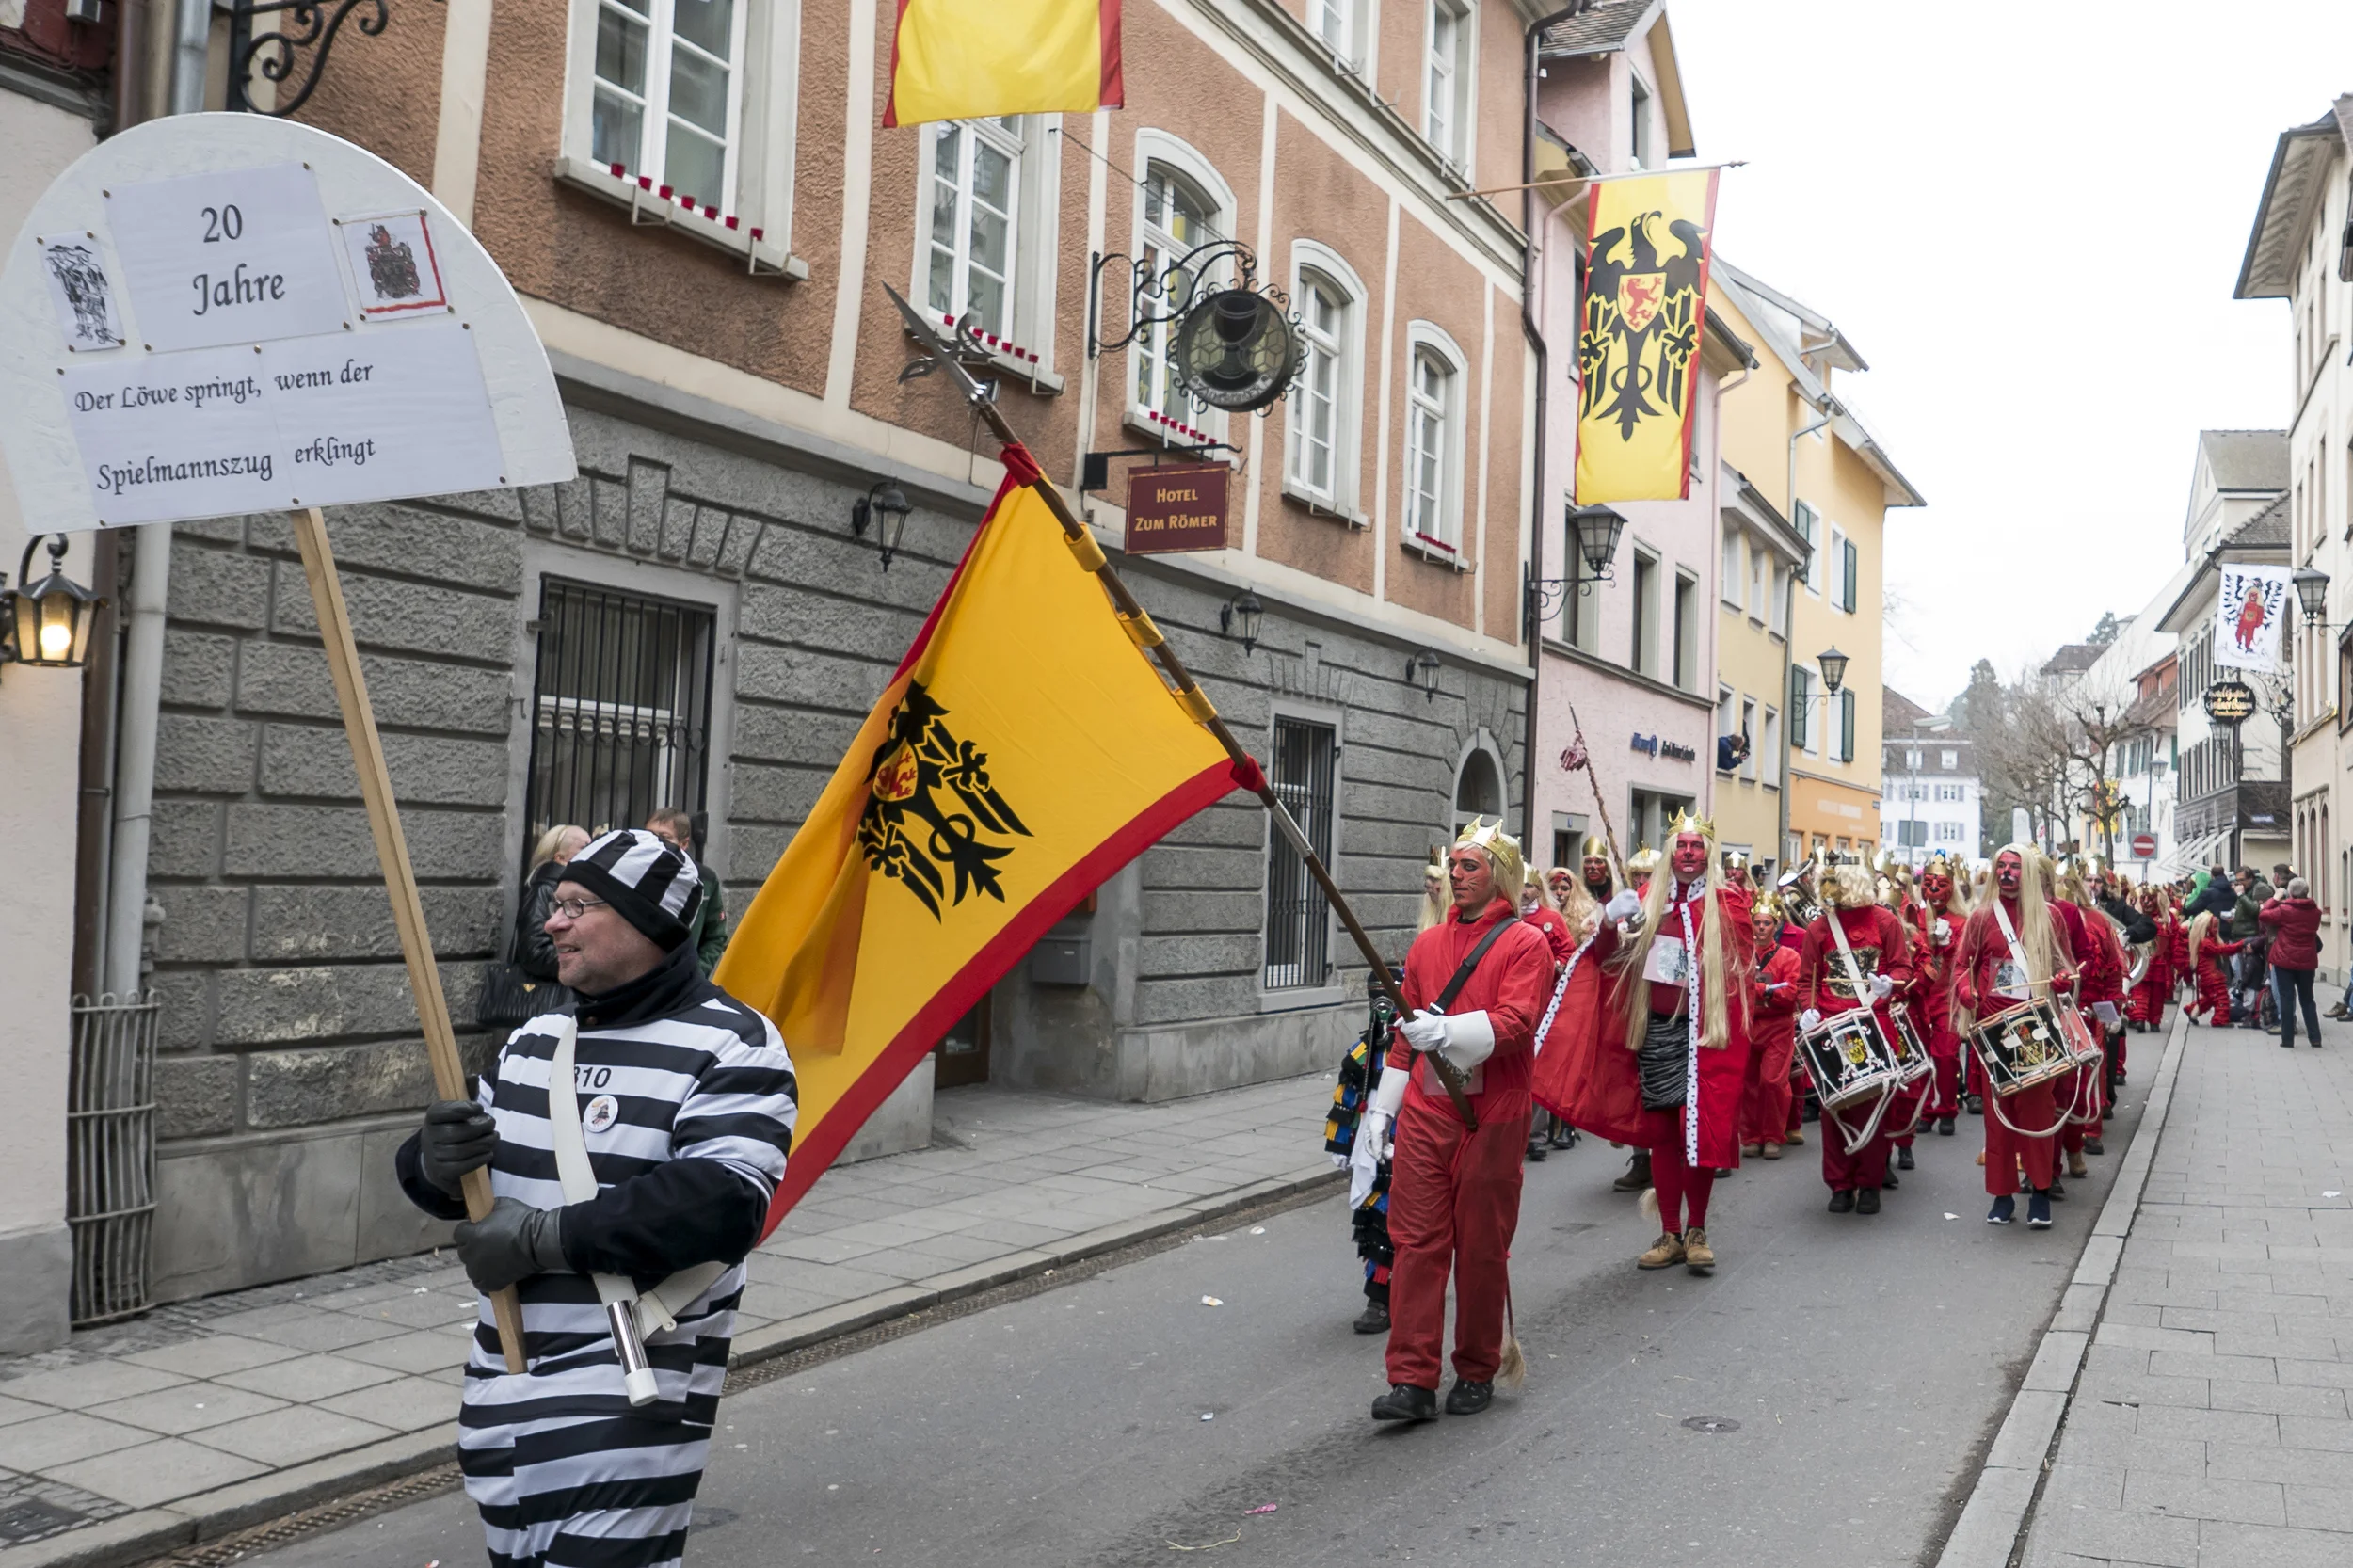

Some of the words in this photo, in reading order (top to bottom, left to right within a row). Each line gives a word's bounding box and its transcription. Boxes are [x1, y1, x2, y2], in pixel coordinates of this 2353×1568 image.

[200, 203, 243, 244] 20
[192, 262, 286, 317] Jahre
[74, 389, 115, 412] Der
[120, 385, 178, 408] Löwe
[184, 376, 262, 408] springt,
[274, 369, 334, 392] wenn
[340, 358, 374, 384] der
[96, 454, 274, 496] Spielmannszug
[294, 436, 376, 467] erklingt
[1156, 488, 1198, 504] HOTEL
[1134, 517, 1165, 532] ZUM
[1168, 514, 1217, 530] RÖMER
